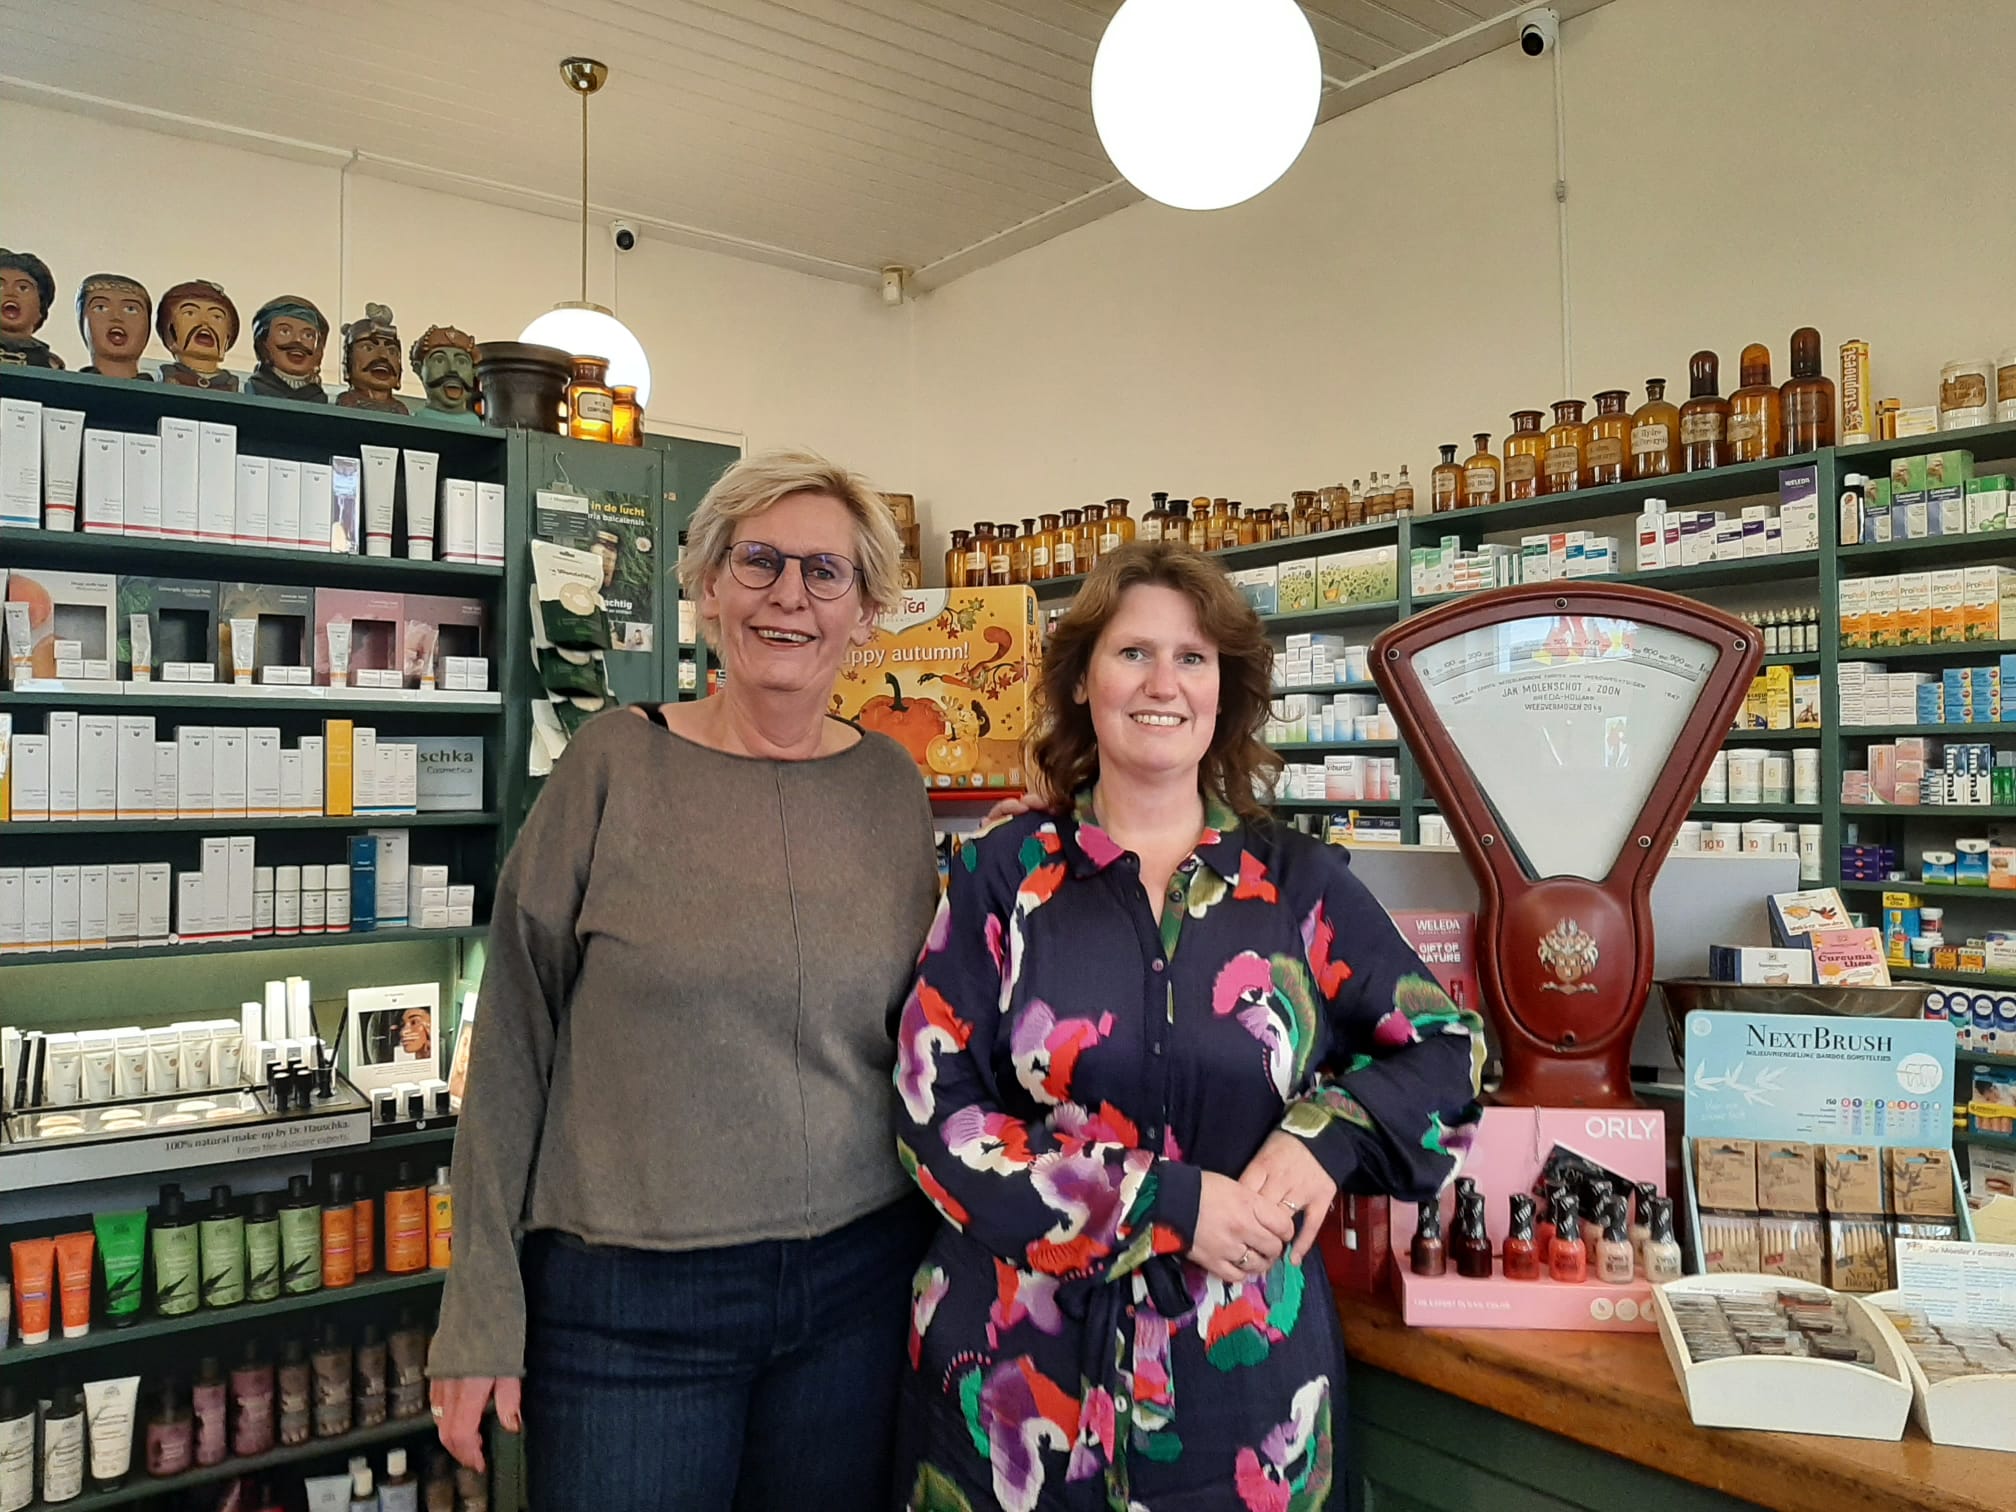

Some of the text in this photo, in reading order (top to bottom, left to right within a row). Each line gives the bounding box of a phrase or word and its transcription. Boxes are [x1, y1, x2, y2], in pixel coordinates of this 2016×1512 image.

[604, 503, 617, 513] de
[620, 505, 645, 517] lucht
[892, 641, 969, 662] autumn!
[1502, 686, 1519, 698] JAN
[1522, 681, 1583, 694] MOLENSCHOT
[1596, 684, 1622, 696] ZOON
[418, 749, 474, 764] schka
[426, 765, 473, 775] Cosmetica
[1703, 840, 1714, 850] 10
[1715, 839, 1724, 849] 10
[1749, 839, 1758, 849] 10
[1777, 842, 1788, 853] 11
[1805, 842, 1813, 852] 11
[1416, 919, 1460, 931] WELEDA
[1419, 942, 1459, 954] GIFT OF
[1419, 952, 1461, 963] NATURE
[1817, 954, 1874, 963] Curcuma
[1844, 960, 1873, 968] thee
[1585, 1116, 1658, 1141] ORLY
[194, 1135, 229, 1147] natural
[276, 1129, 286, 1139] by
